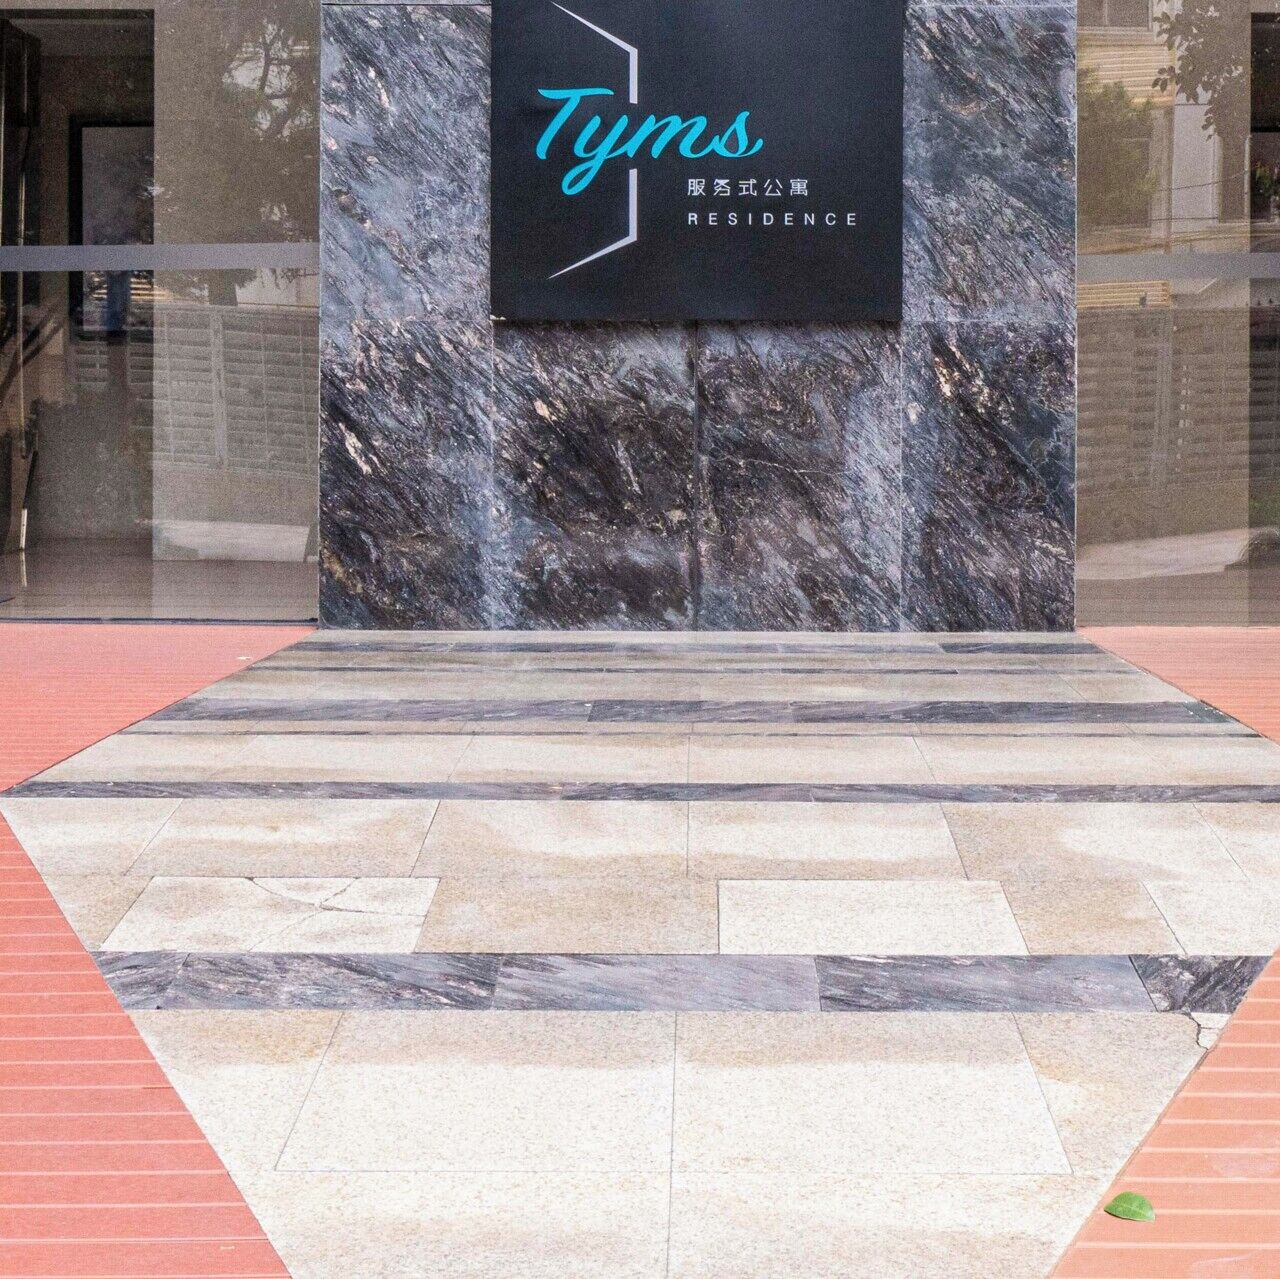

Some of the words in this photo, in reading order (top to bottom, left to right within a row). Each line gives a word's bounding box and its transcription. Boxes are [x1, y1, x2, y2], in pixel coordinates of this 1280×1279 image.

[536, 88, 764, 196] Tyms
[687, 178, 809, 197] 服务式公寓
[687, 212, 857, 226] RESIDENCE
